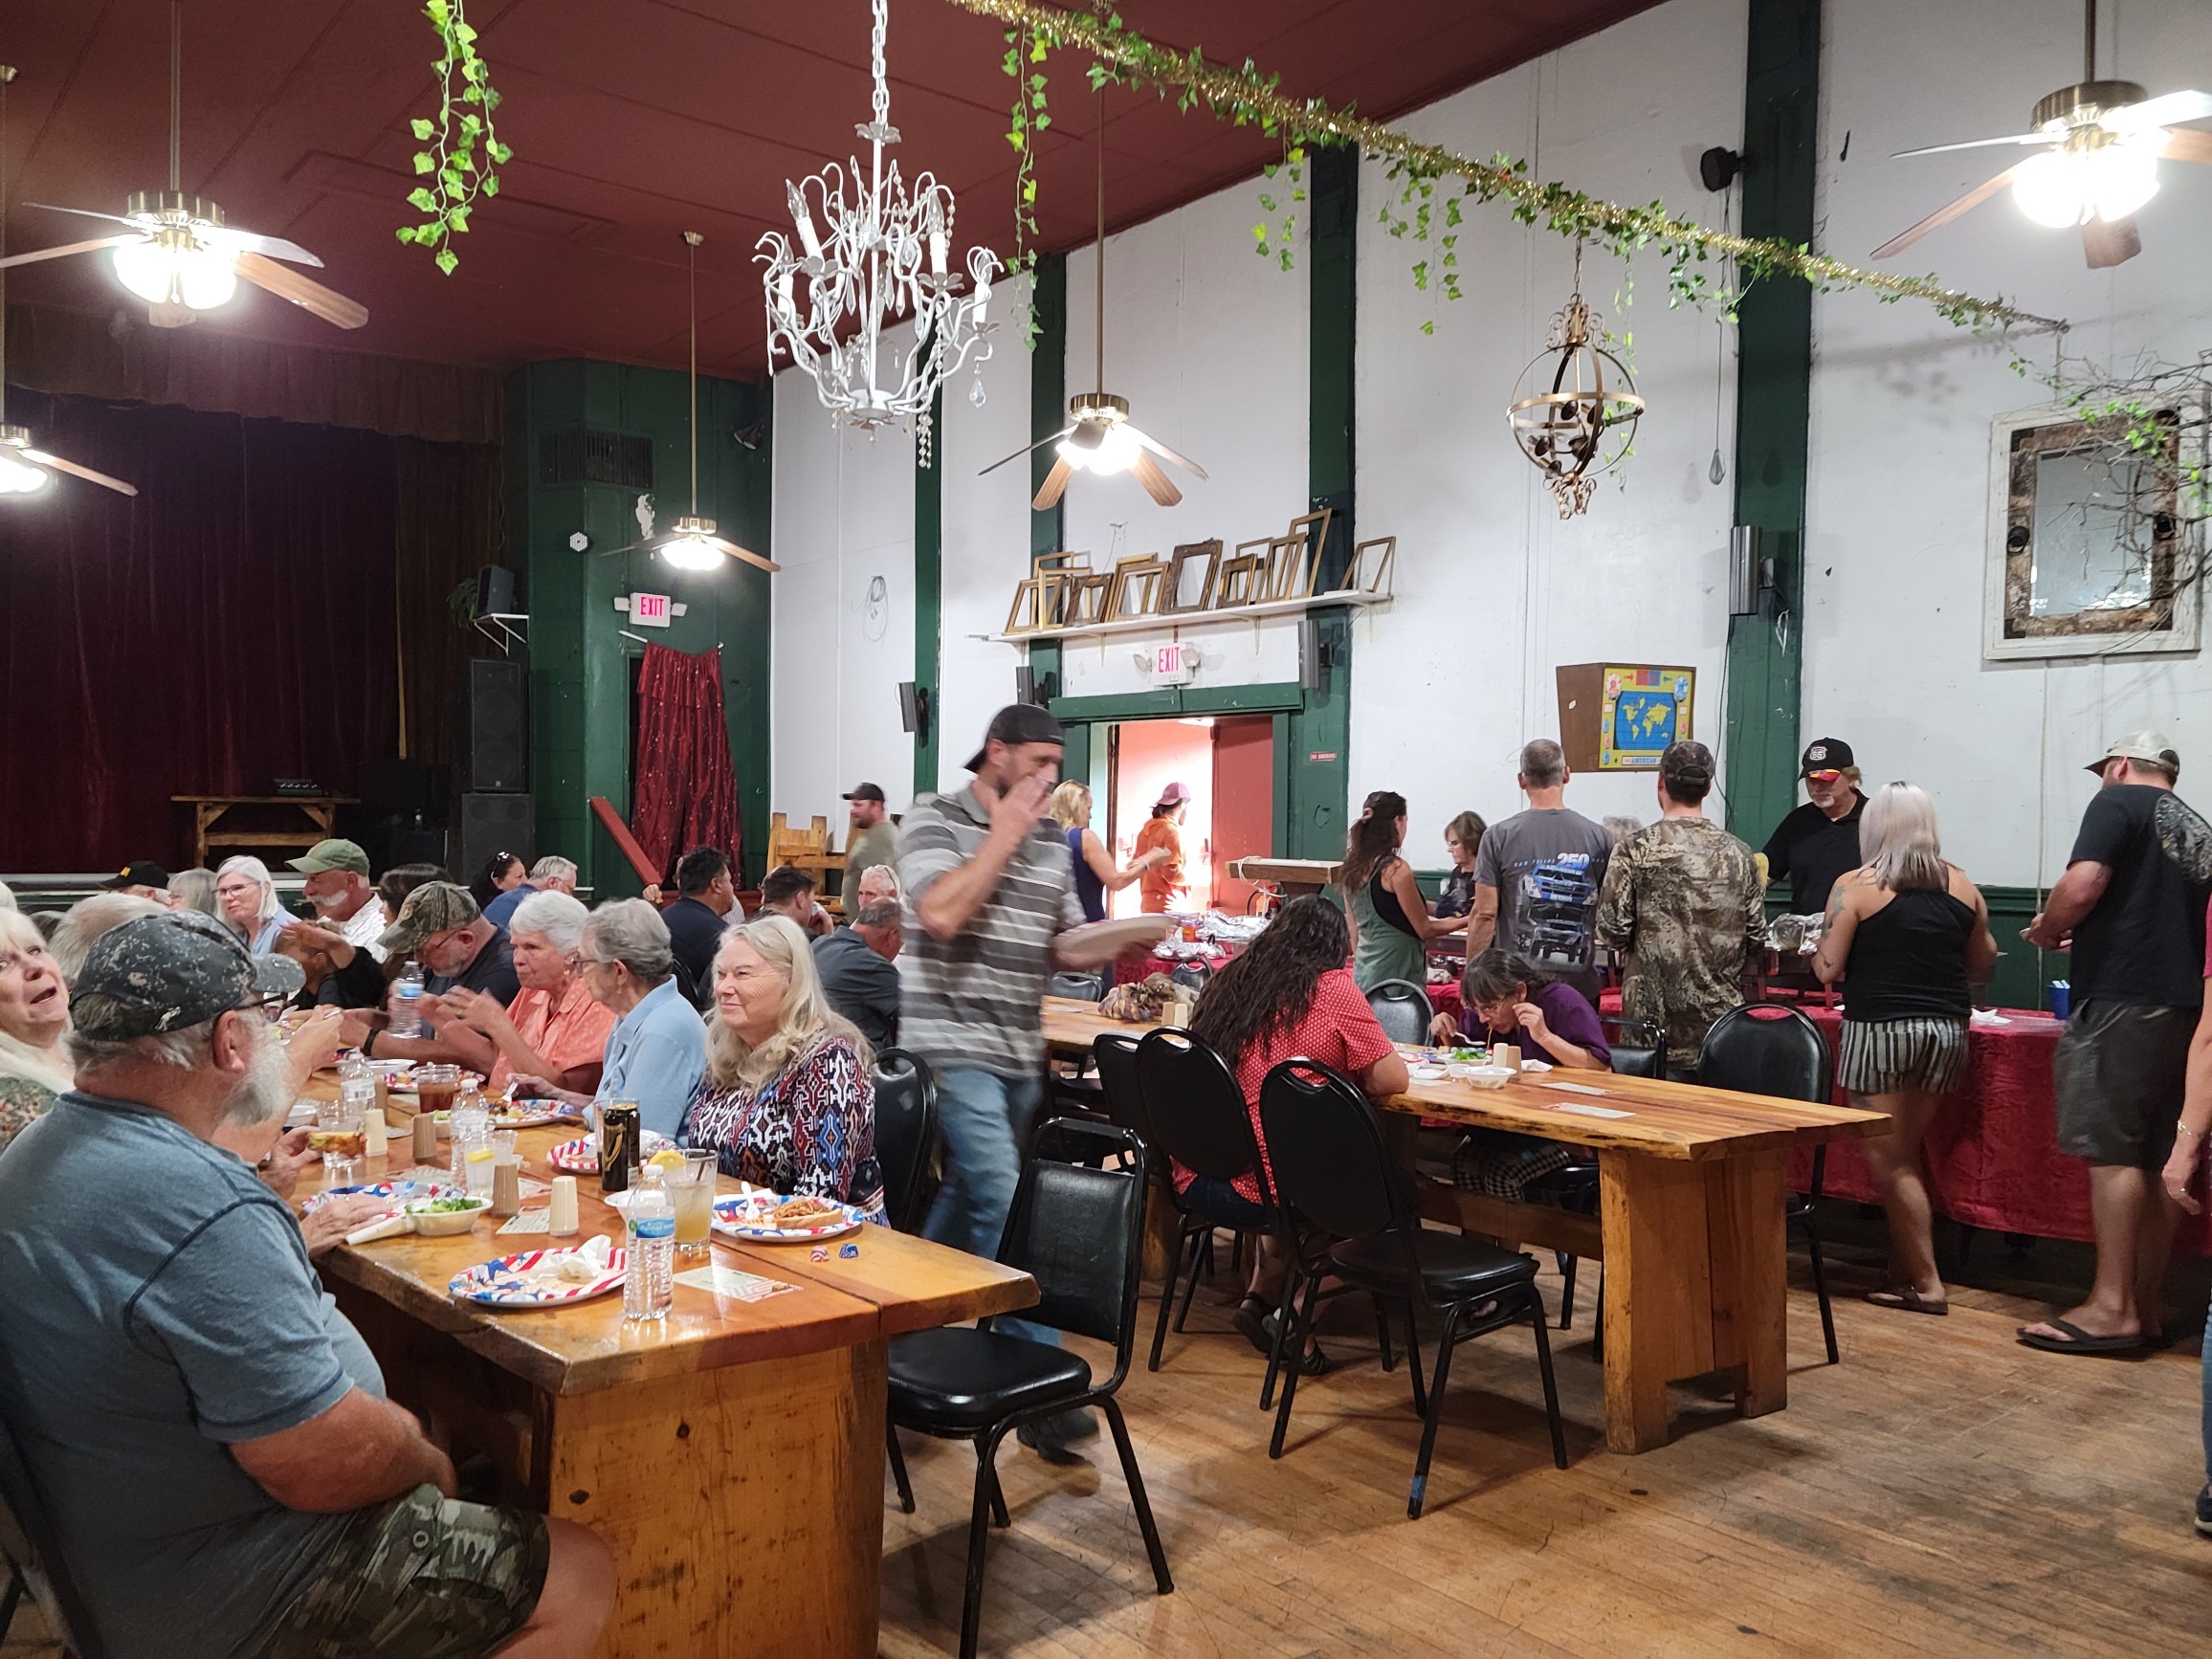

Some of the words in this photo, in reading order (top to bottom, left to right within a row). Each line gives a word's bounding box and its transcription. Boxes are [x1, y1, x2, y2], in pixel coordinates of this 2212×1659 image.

[640, 597, 664, 616] EXIT
[1159, 647, 1180, 673] EXIT
[1557, 852, 1590, 872] 250
